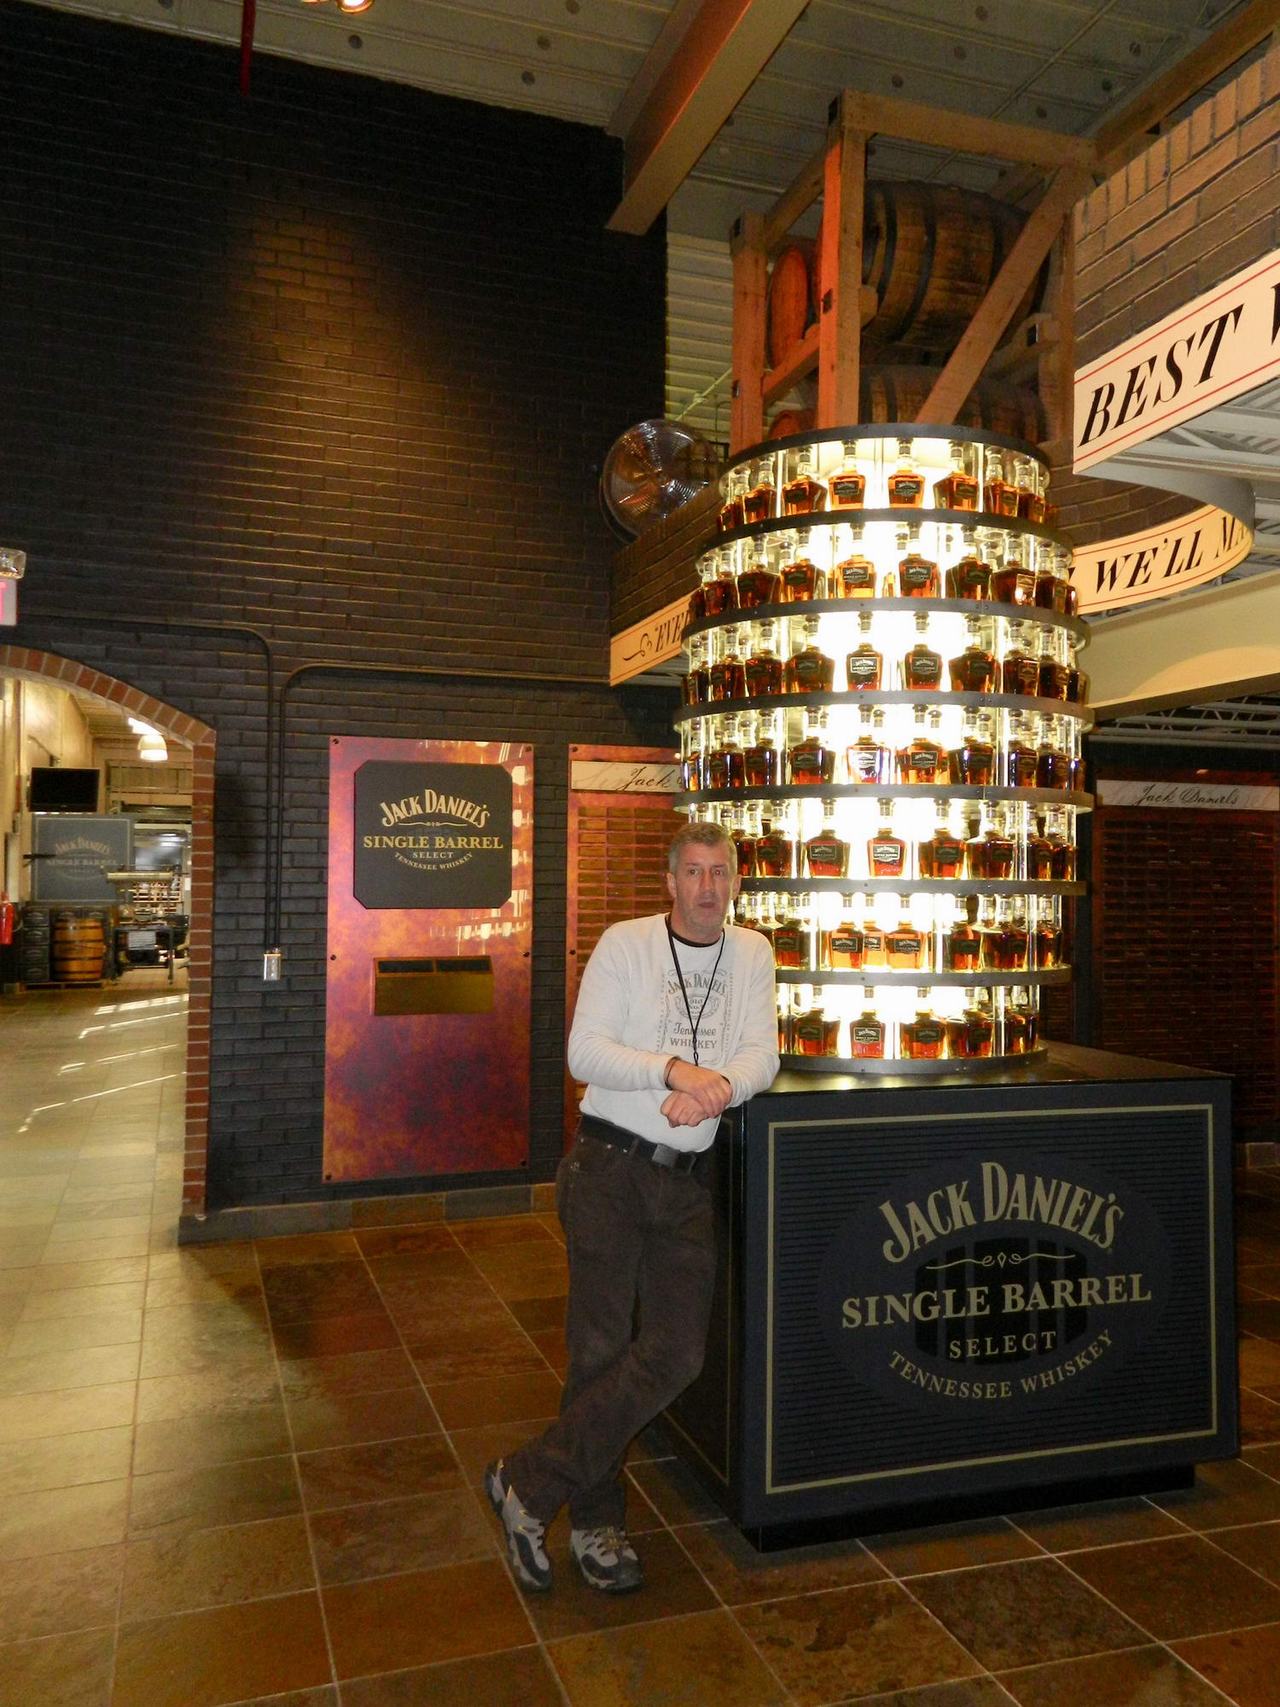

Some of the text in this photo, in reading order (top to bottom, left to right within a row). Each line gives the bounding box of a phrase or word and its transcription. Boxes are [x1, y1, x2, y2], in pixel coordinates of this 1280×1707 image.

[1077, 302, 1245, 448] BEST
[1096, 528, 1204, 595] WE'LL
[616, 766, 675, 791] Jack
[379, 788, 490, 829] JACK DANIEL'S
[1133, 784, 1178, 807] Jack
[363, 835, 504, 849] SINGLE BARREL
[412, 851, 455, 859] SELECT
[394, 851, 474, 871] TENNESSEE WHISKEY
[670, 1037, 717, 1049] WHIKEY
[878, 1160, 1125, 1263] JACK DANIEL'S
[841, 1272, 1152, 1329] SINGLE BARREL
[949, 1330, 1058, 1360] SELECT
[887, 1328, 1114, 1399] TENNESSEE WHISKEY
